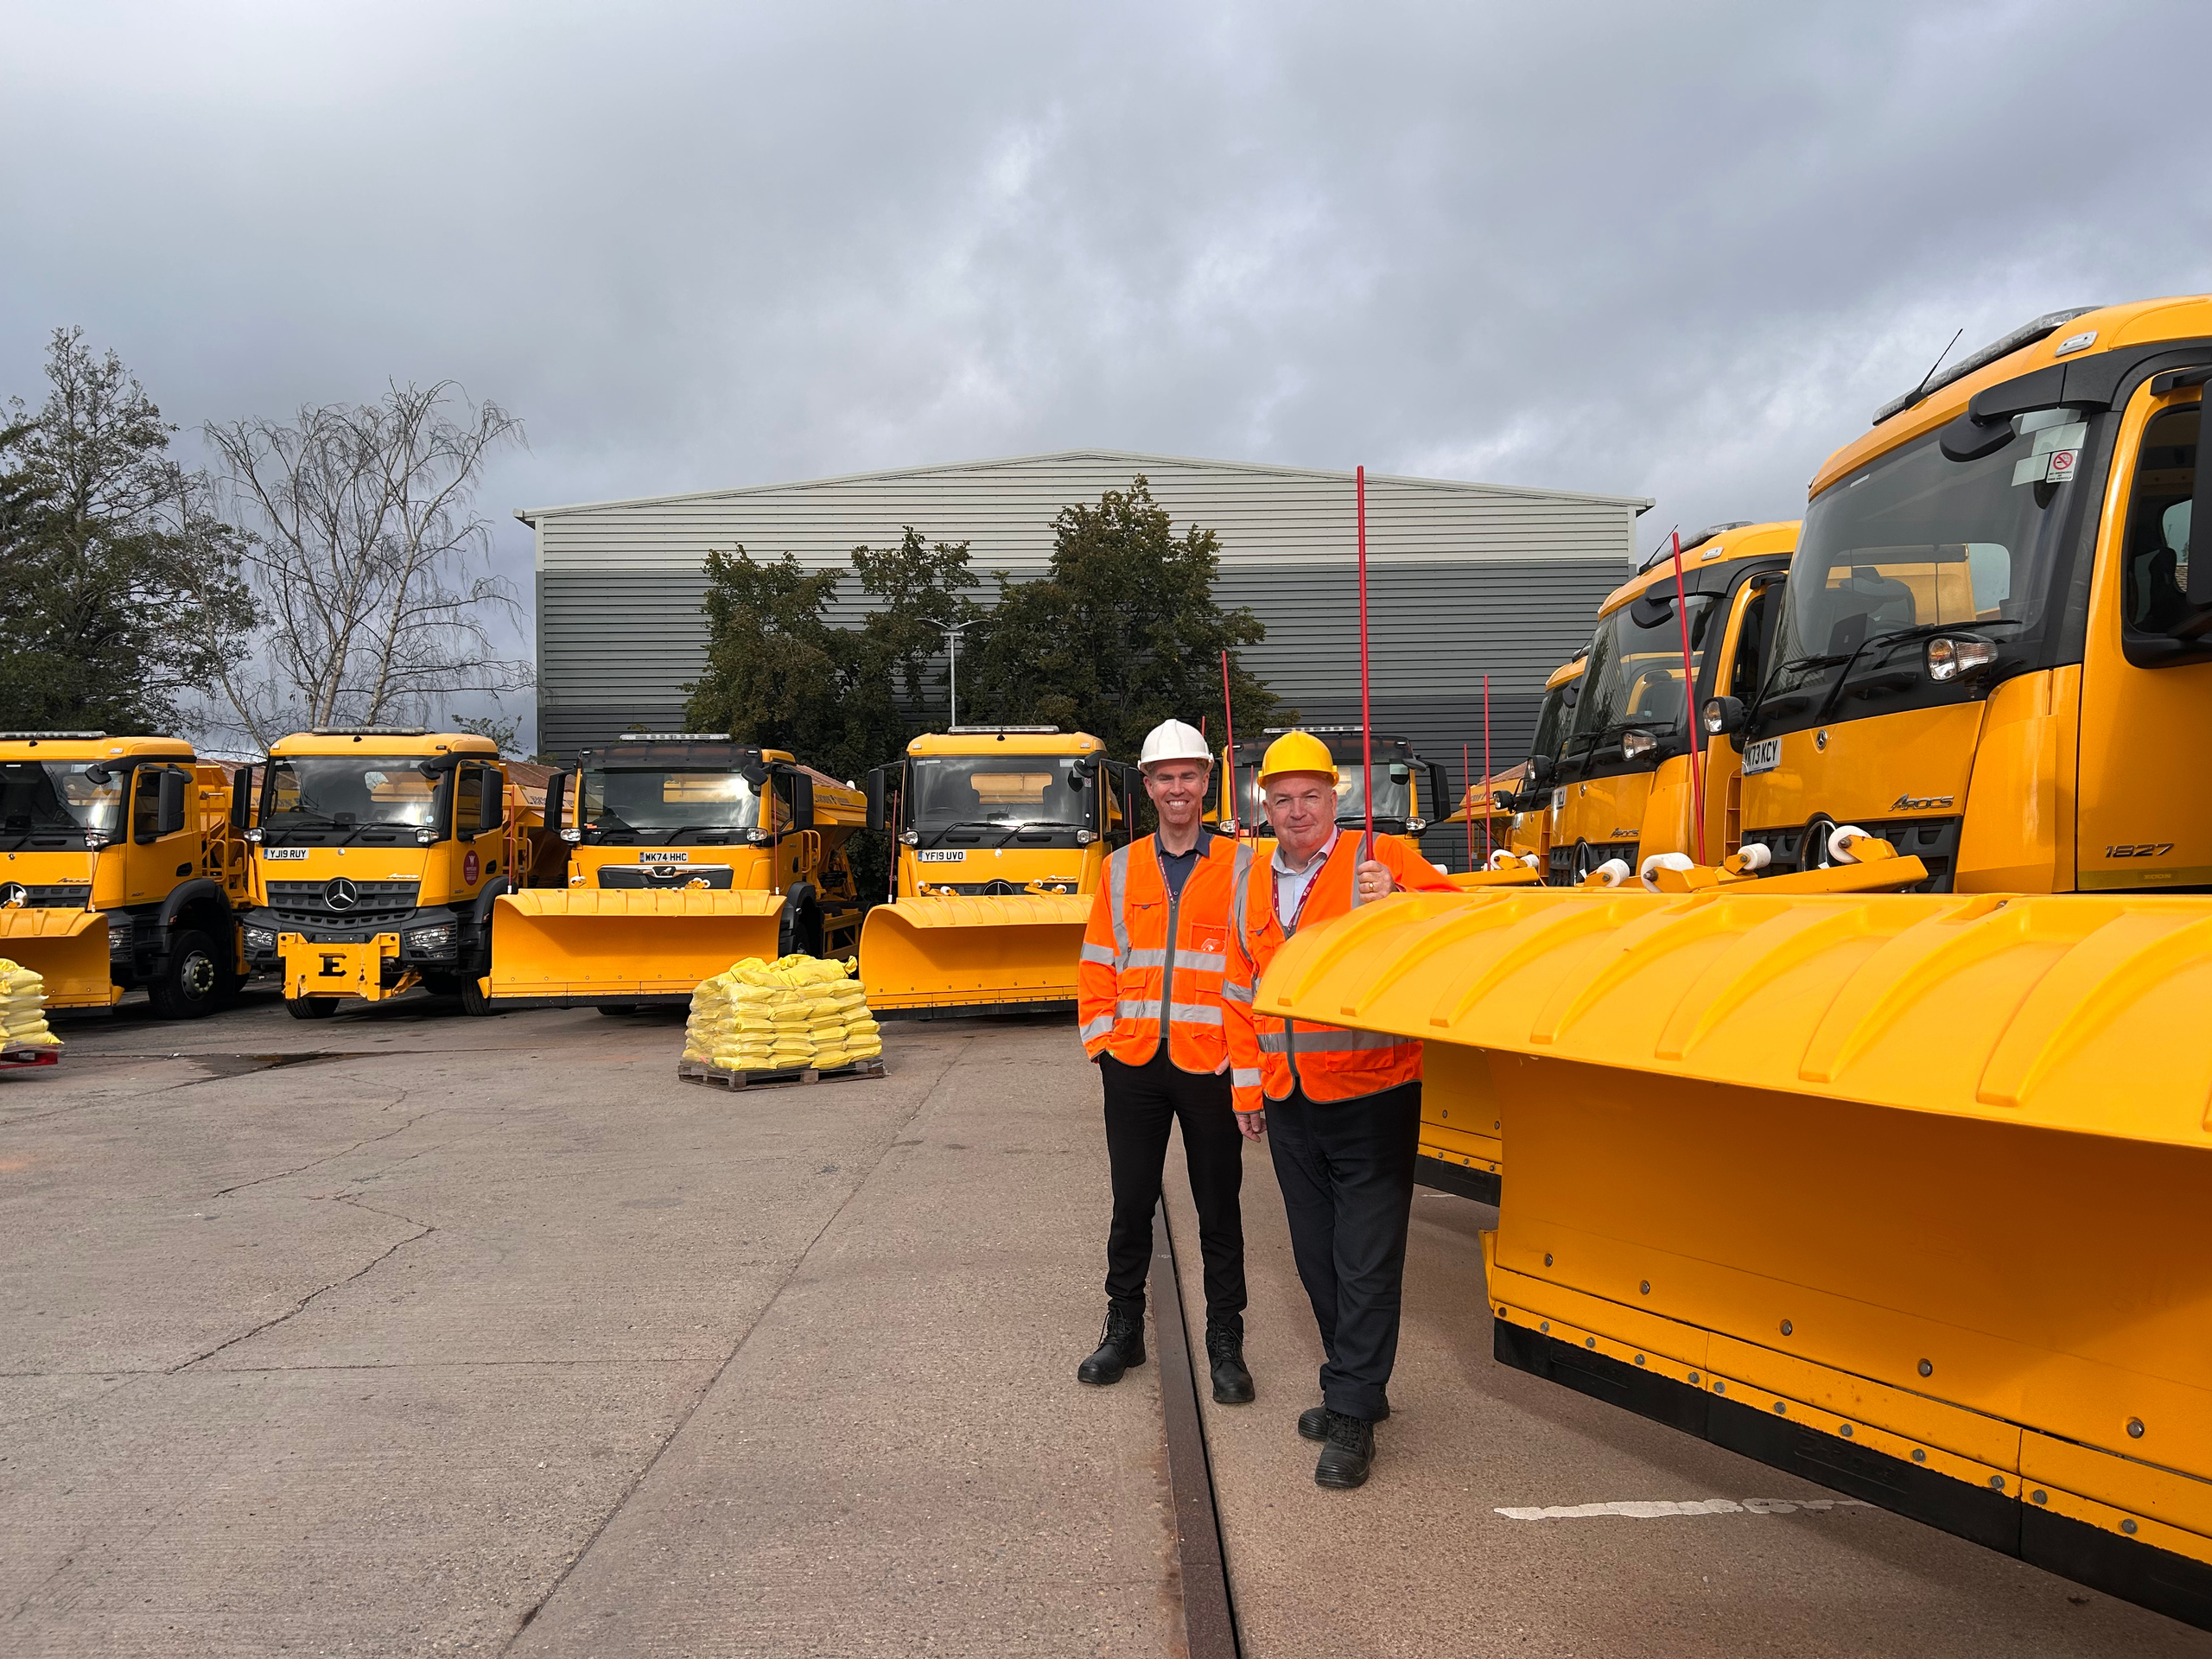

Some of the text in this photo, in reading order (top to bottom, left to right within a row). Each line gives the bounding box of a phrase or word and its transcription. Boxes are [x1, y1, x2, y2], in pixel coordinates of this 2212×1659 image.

[1761, 740, 1778, 764] KCY
[645, 853, 668, 861] WK74
[946, 851, 963, 860] UVO
[2105, 842, 2175, 858] 1827
[318, 952, 347, 977] E
